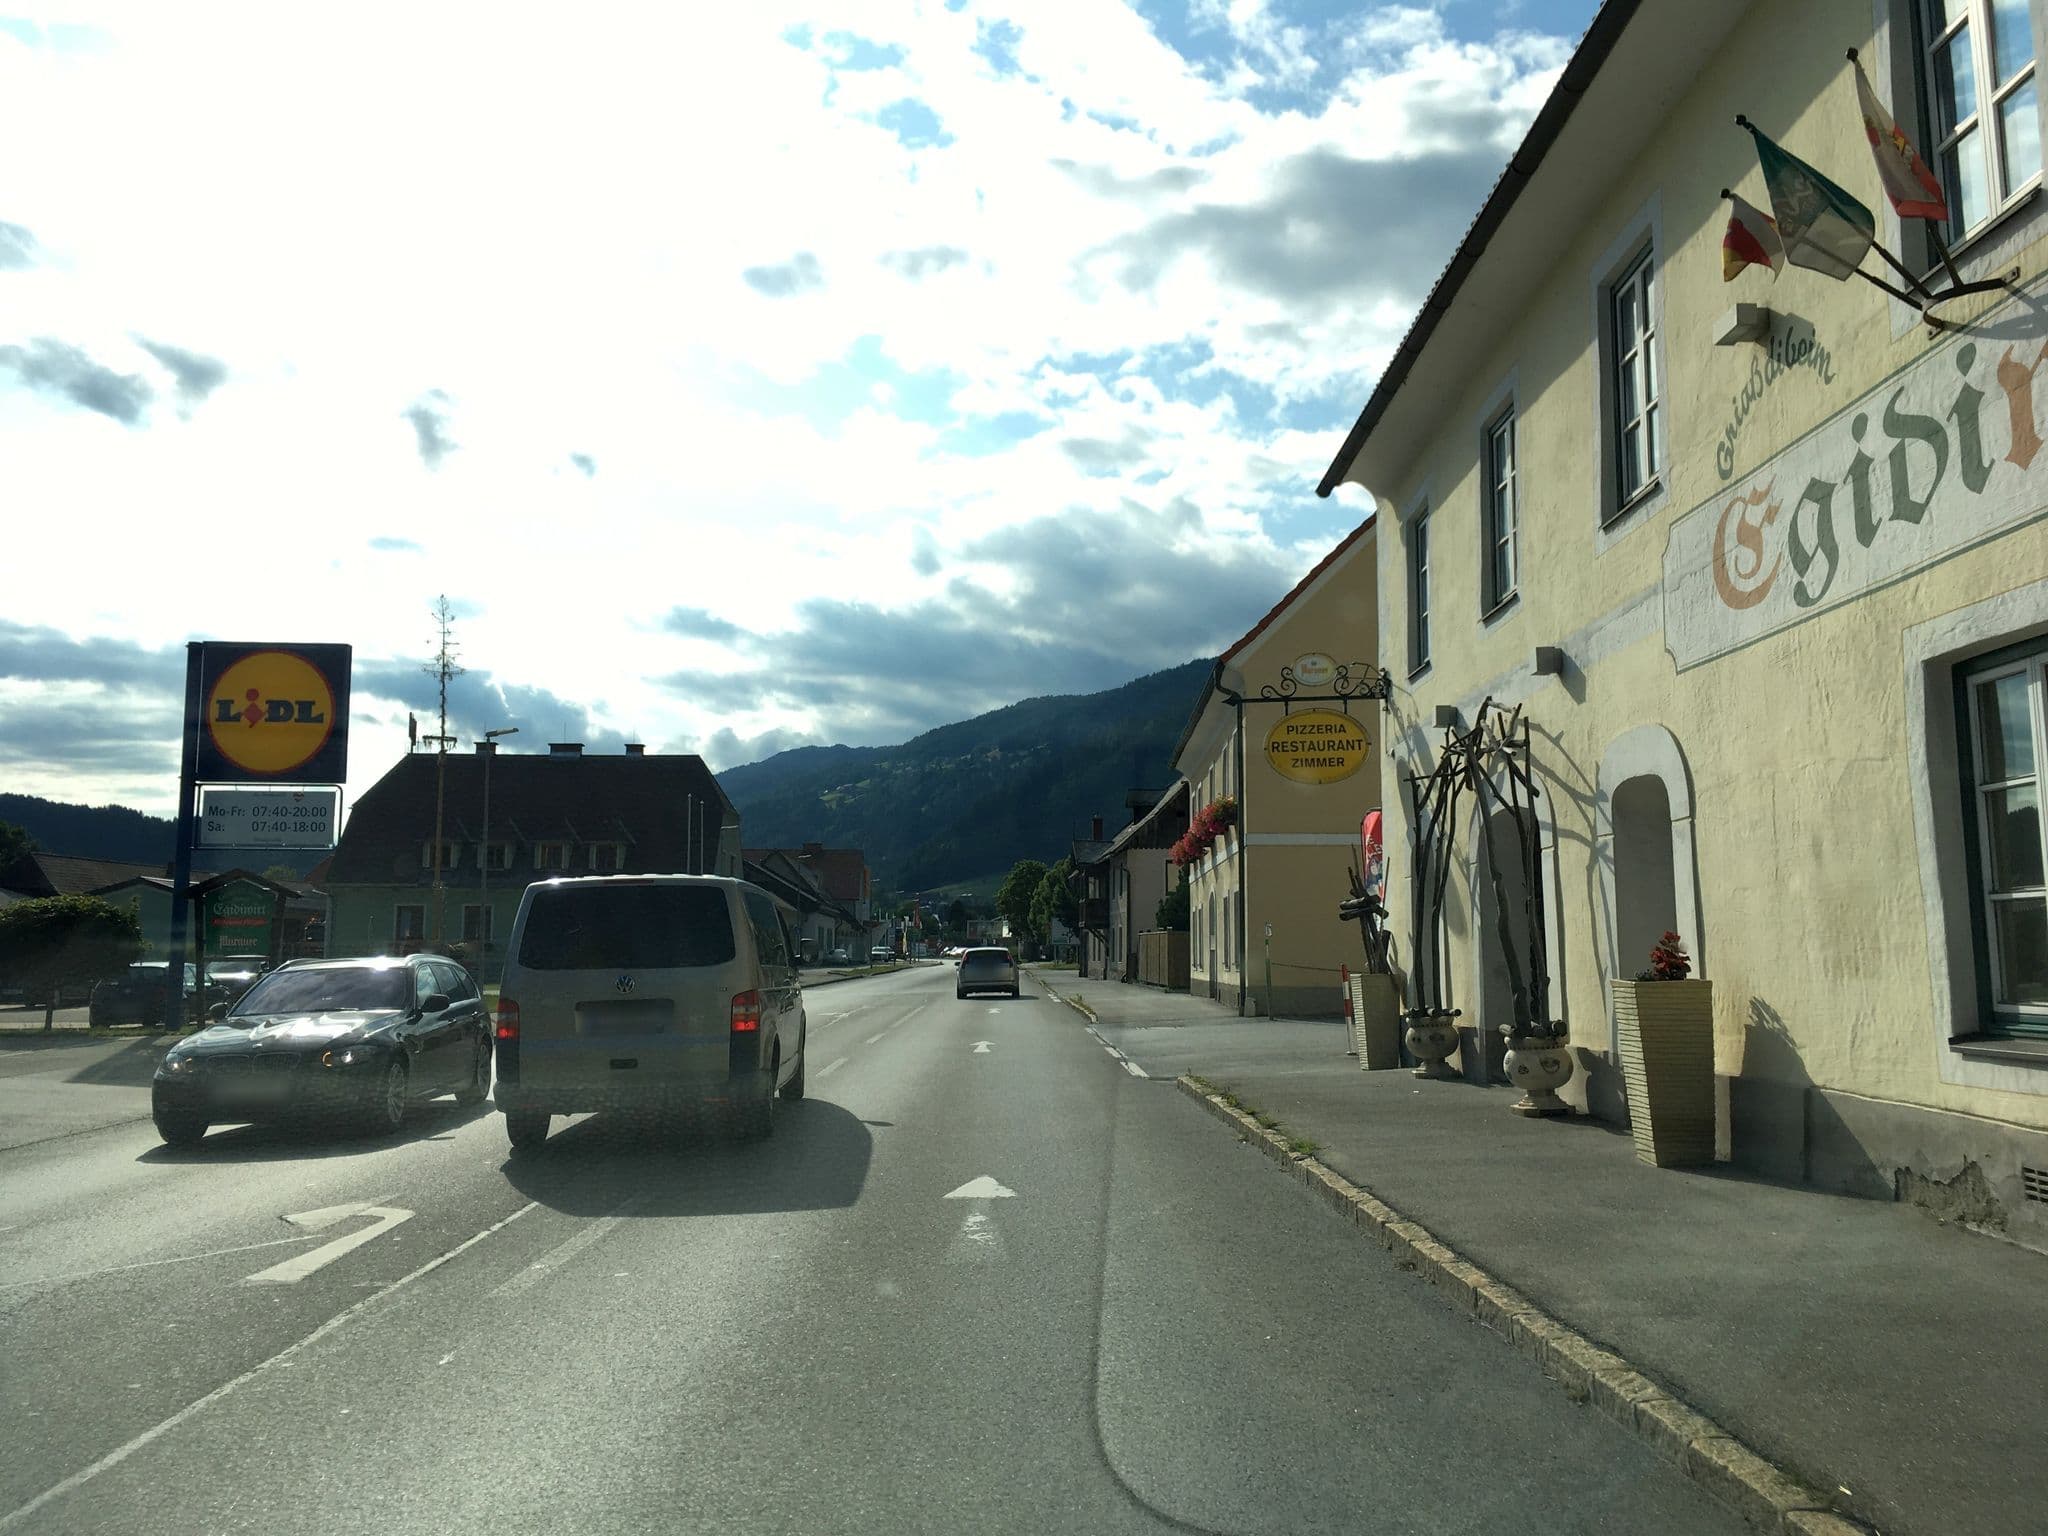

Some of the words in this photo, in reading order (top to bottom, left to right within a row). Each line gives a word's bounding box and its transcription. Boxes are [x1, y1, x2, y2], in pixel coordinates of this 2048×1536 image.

[1286, 723, 1347, 735] PIZZERIA
[1271, 738, 1364, 753] RESTAURANT
[1291, 756, 1345, 769] ZIMMER
[208, 805, 246, 817] Mo-Fr:
[252, 806, 328, 817] 07:40-20:00
[207, 820, 226, 832] Sa:
[251, 821, 326, 832] 07:40-18:00
